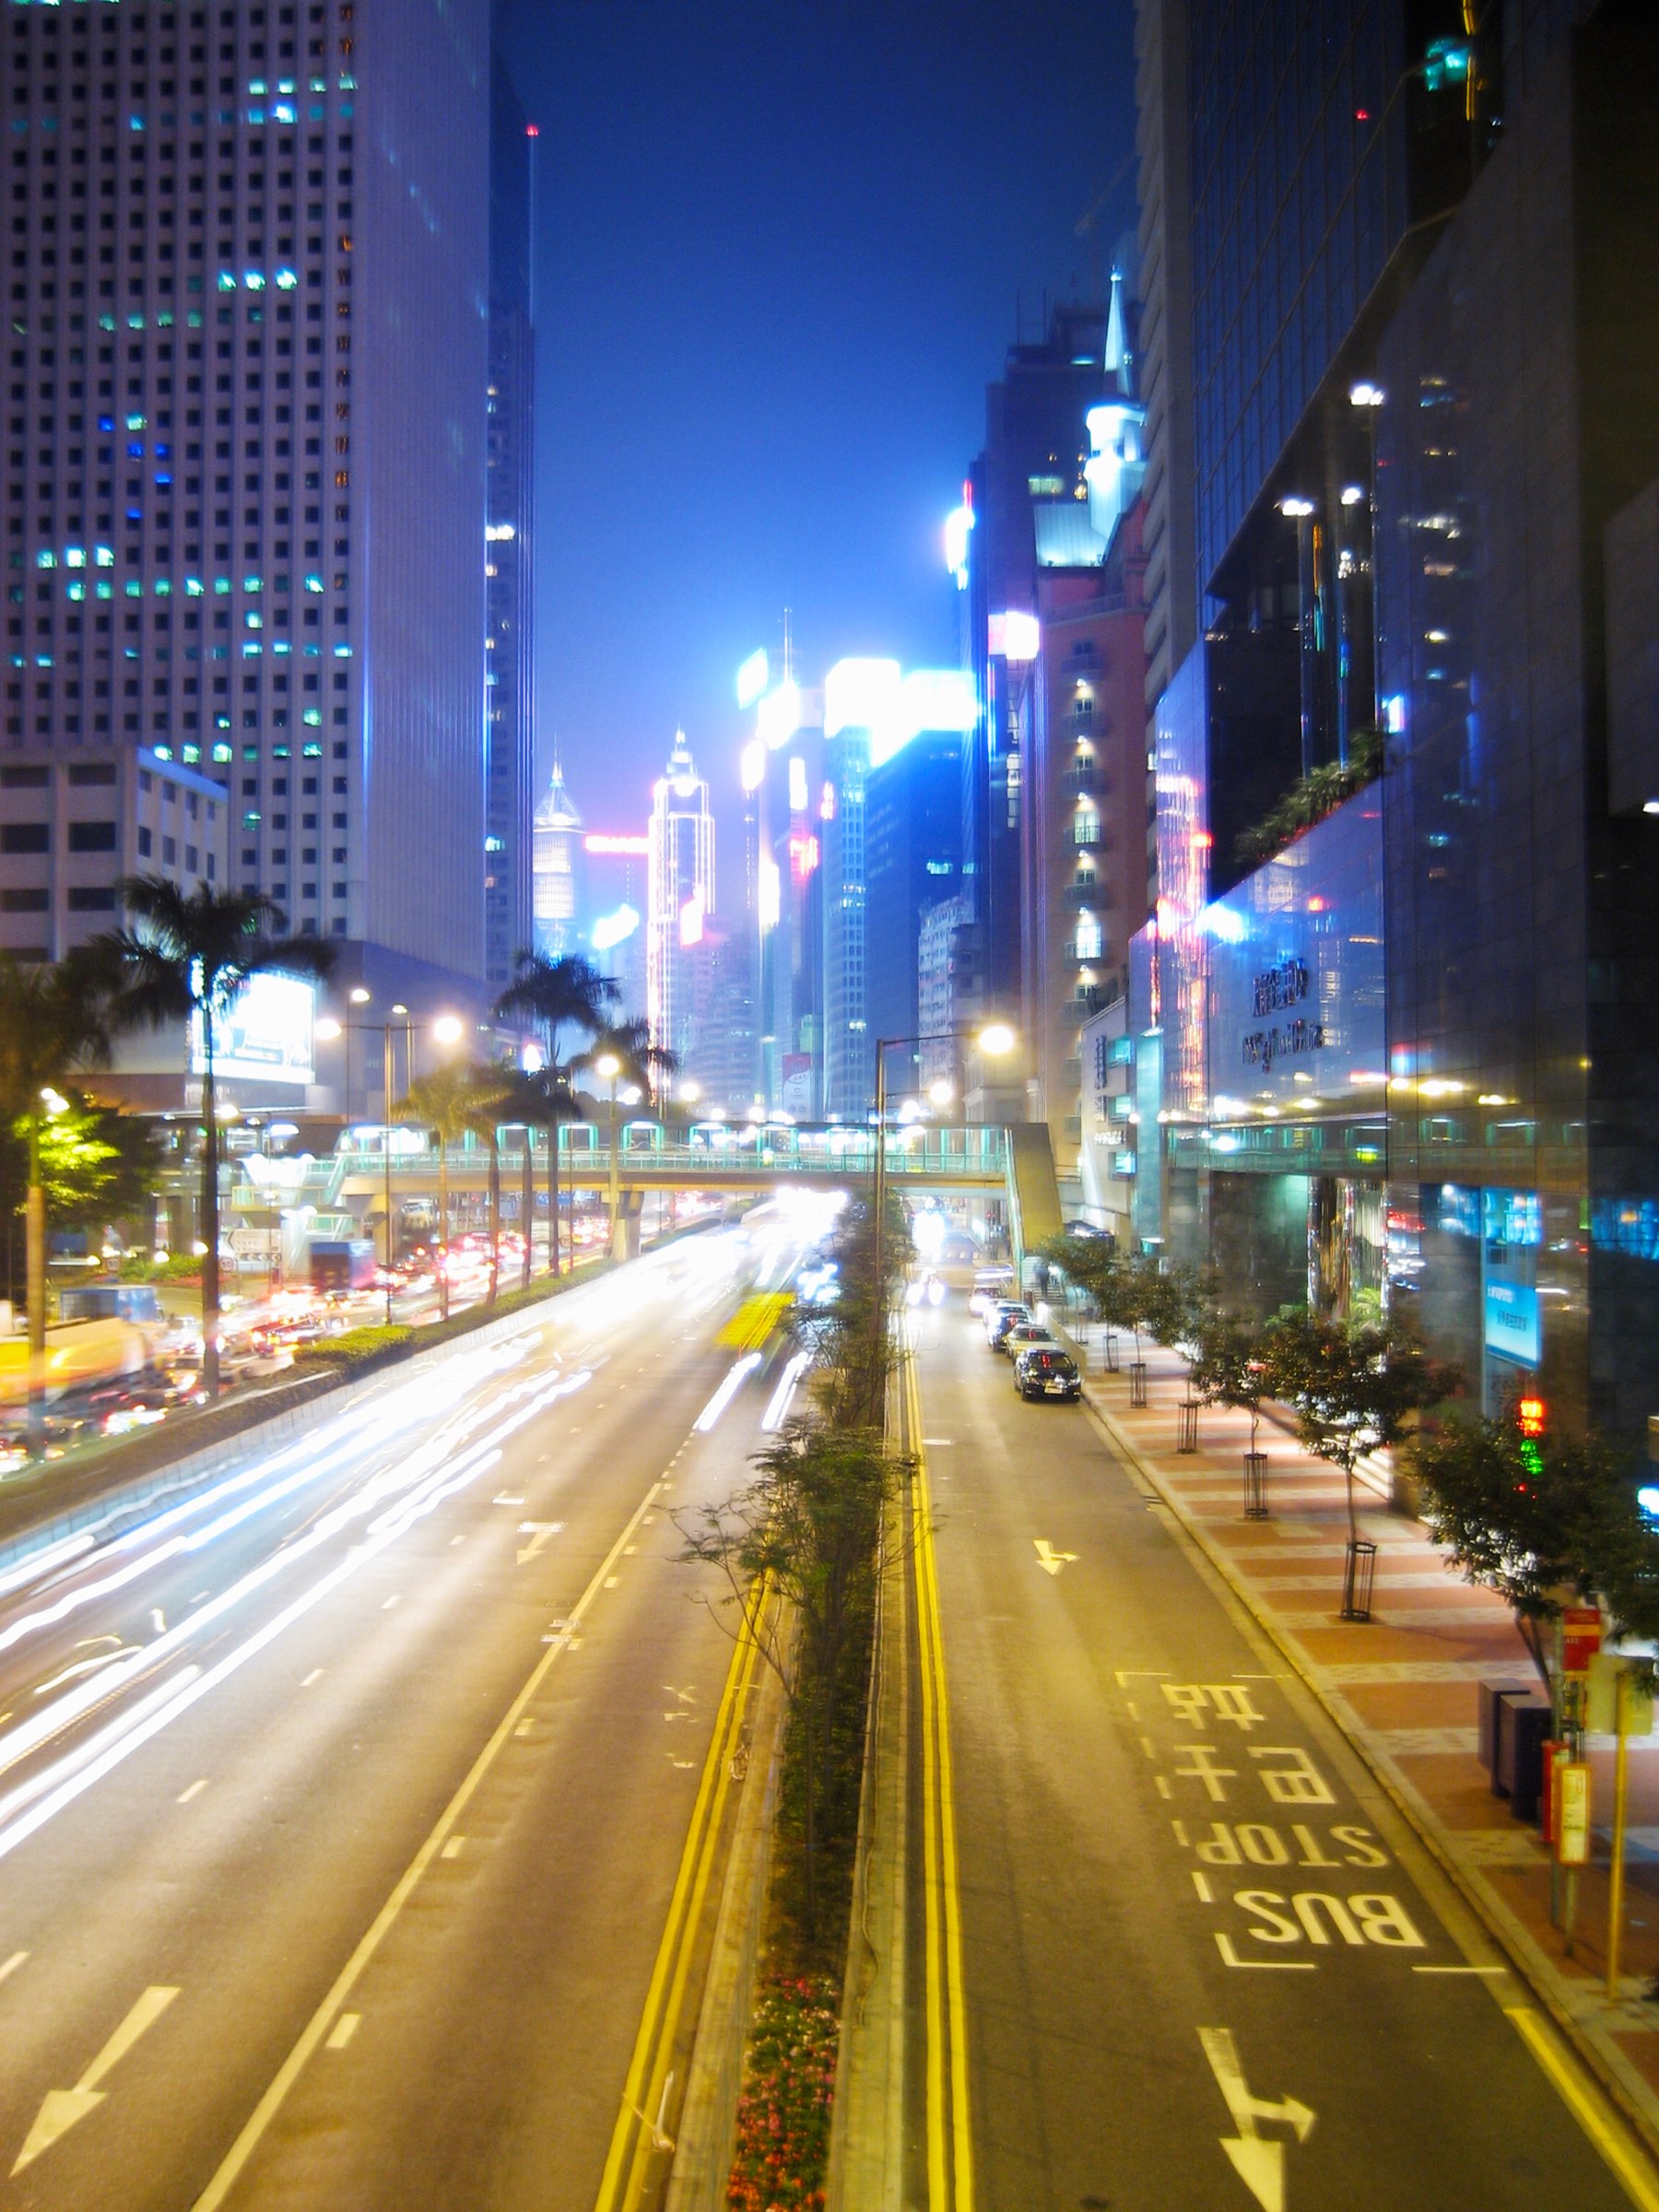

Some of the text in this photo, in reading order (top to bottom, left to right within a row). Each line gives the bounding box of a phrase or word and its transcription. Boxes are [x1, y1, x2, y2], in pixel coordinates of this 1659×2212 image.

[1161, 1685, 1265, 1730] 站
[1174, 1747, 1335, 1805] 巴士
[1196, 1822, 1389, 1867] STOP
[1233, 1890, 1426, 1947] BUS
